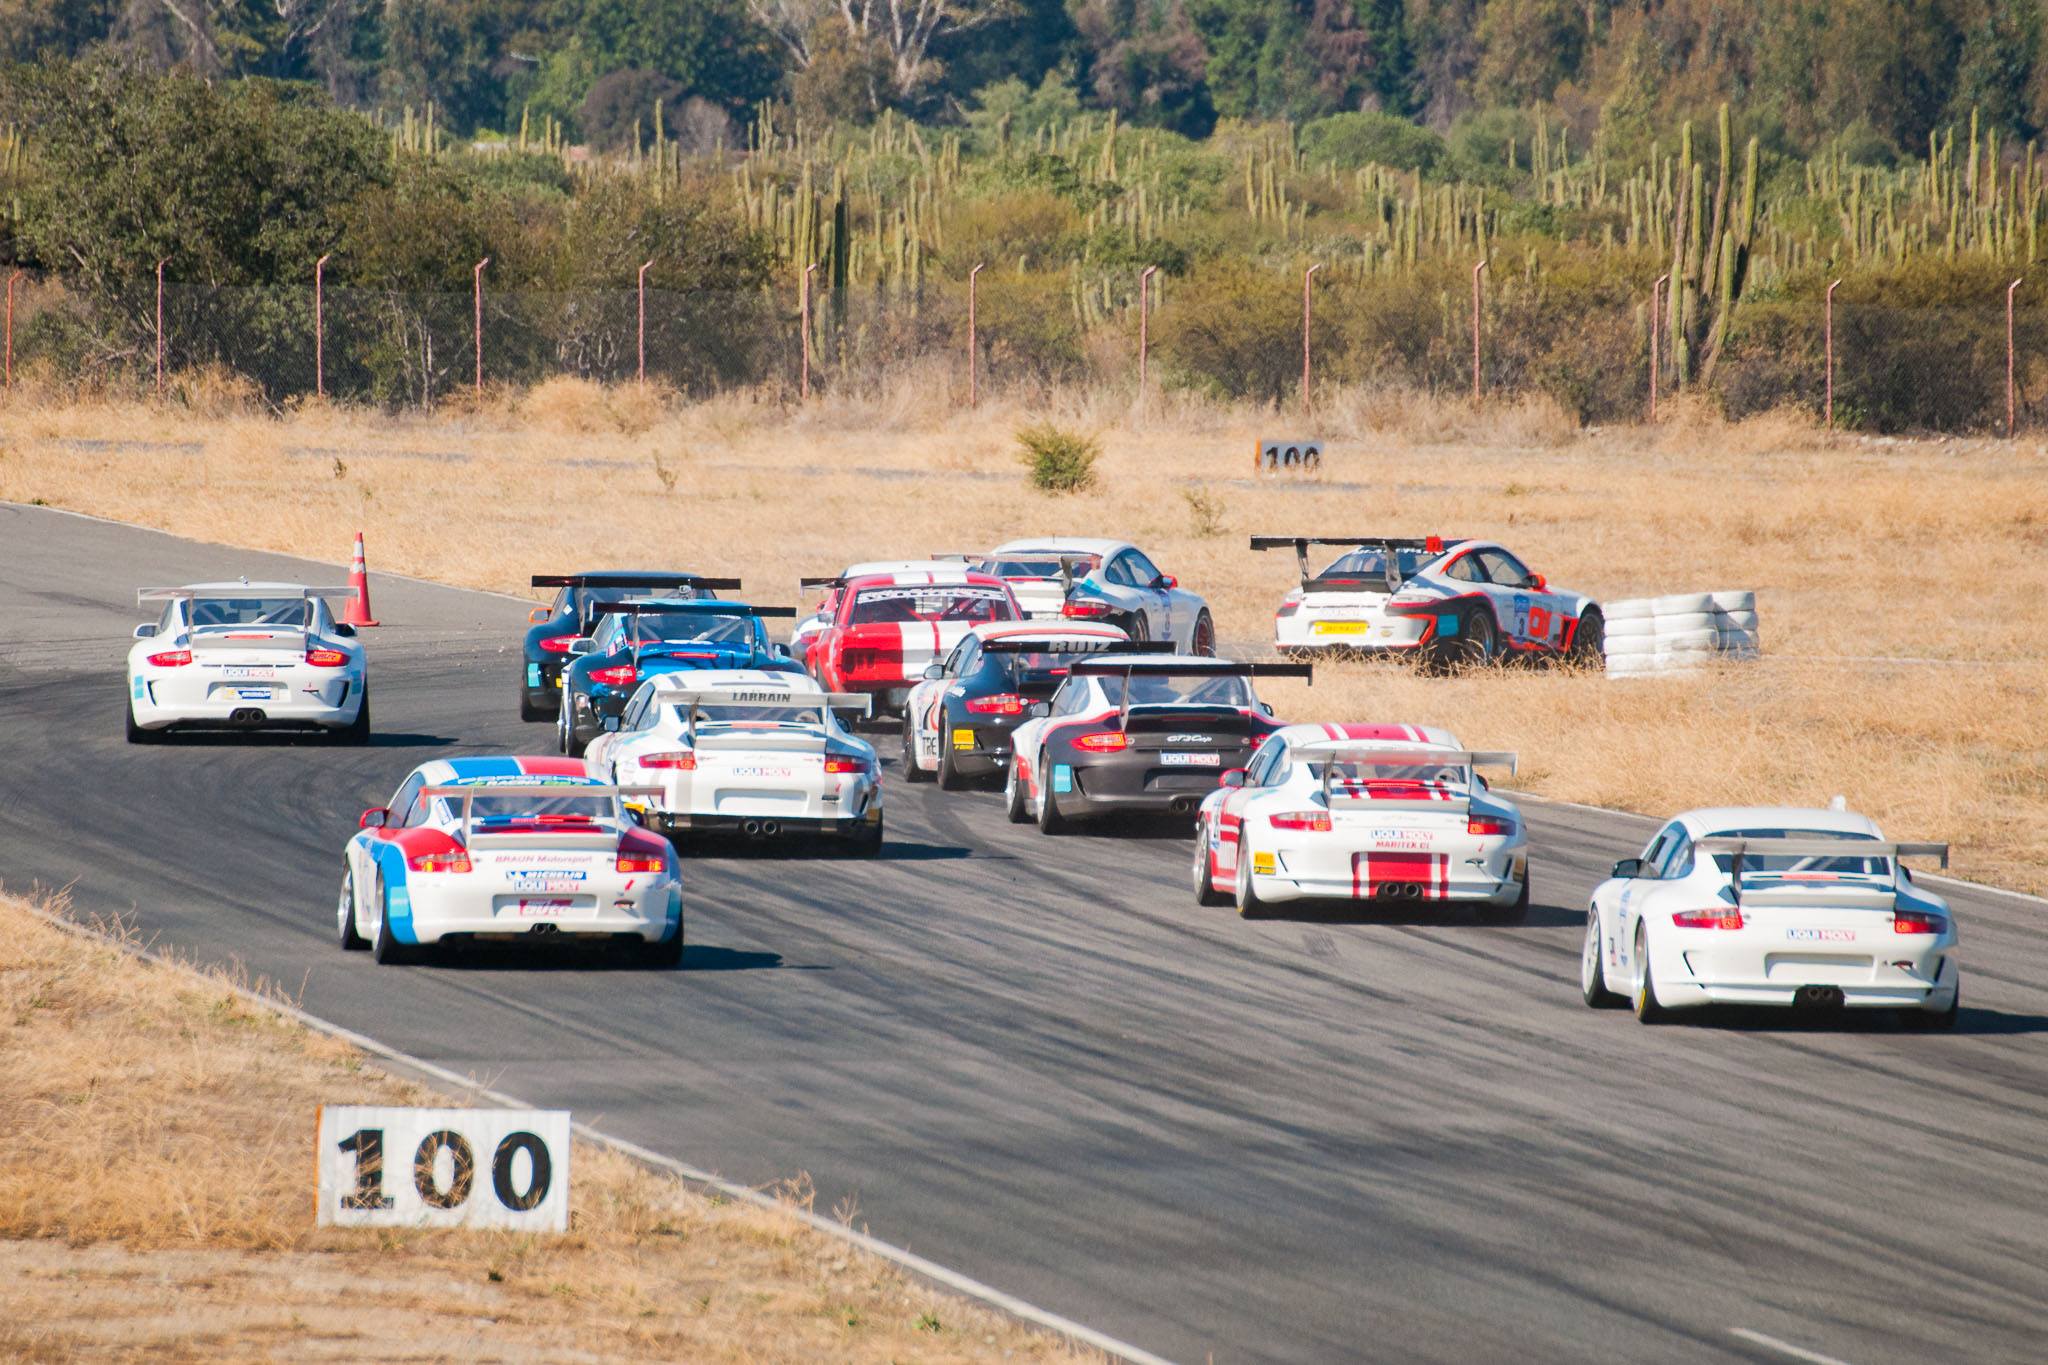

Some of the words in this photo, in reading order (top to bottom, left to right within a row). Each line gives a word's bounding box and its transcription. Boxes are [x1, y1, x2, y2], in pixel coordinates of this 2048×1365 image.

[1048, 641, 1111, 651] RUIZ
[733, 692, 790, 702] LARRAIN
[1162, 754, 1189, 764] LIQUI
[1189, 755, 1219, 765] MOLY
[538, 855, 592, 864] Motorsport
[525, 871, 584, 880] MICHELIN
[1786, 929, 1819, 939] LIQUI
[1820, 930, 1856, 941] MOLY
[338, 1128, 552, 1212] 100
